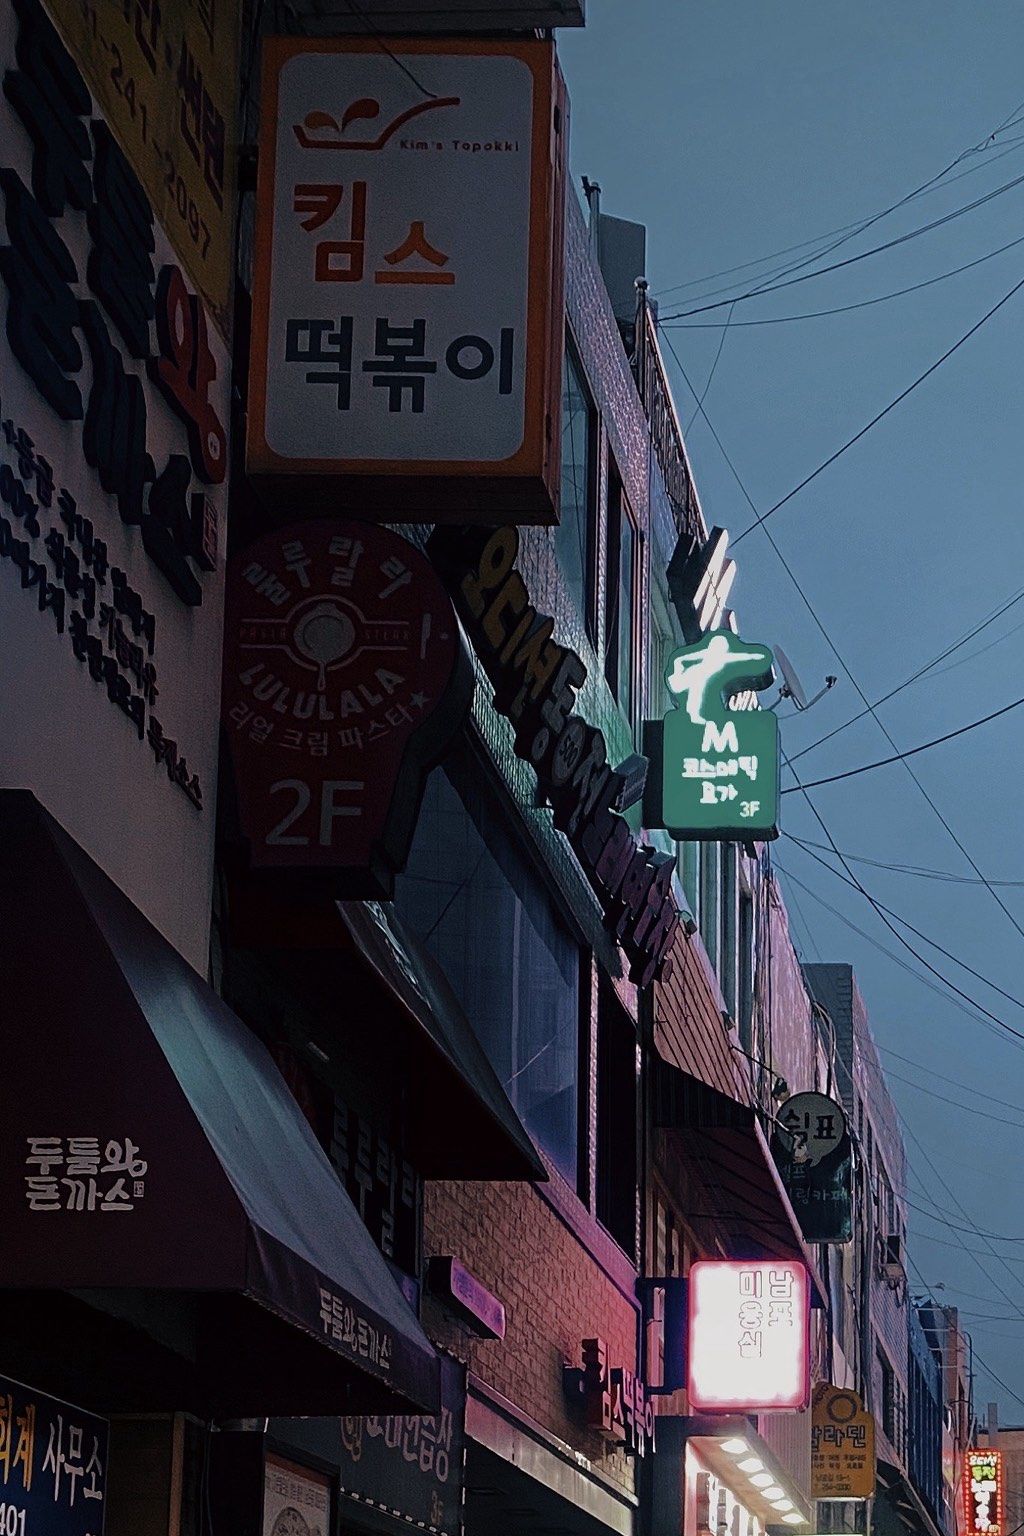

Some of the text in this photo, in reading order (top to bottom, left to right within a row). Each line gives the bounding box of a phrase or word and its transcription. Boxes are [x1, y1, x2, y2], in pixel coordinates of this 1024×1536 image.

[400, 139, 520, 154] Kim's Topokki
[293, 180, 457, 285] 킴스
[285, 315, 514, 413] 떡볶이
[239, 662, 406, 722] LULULALA
[265, 778, 366, 846] 2F
[739, 800, 760, 818] 3F
[24, 1177, 135, 1213] 돈까스
[41, 1413, 103, 1508] 사무소
